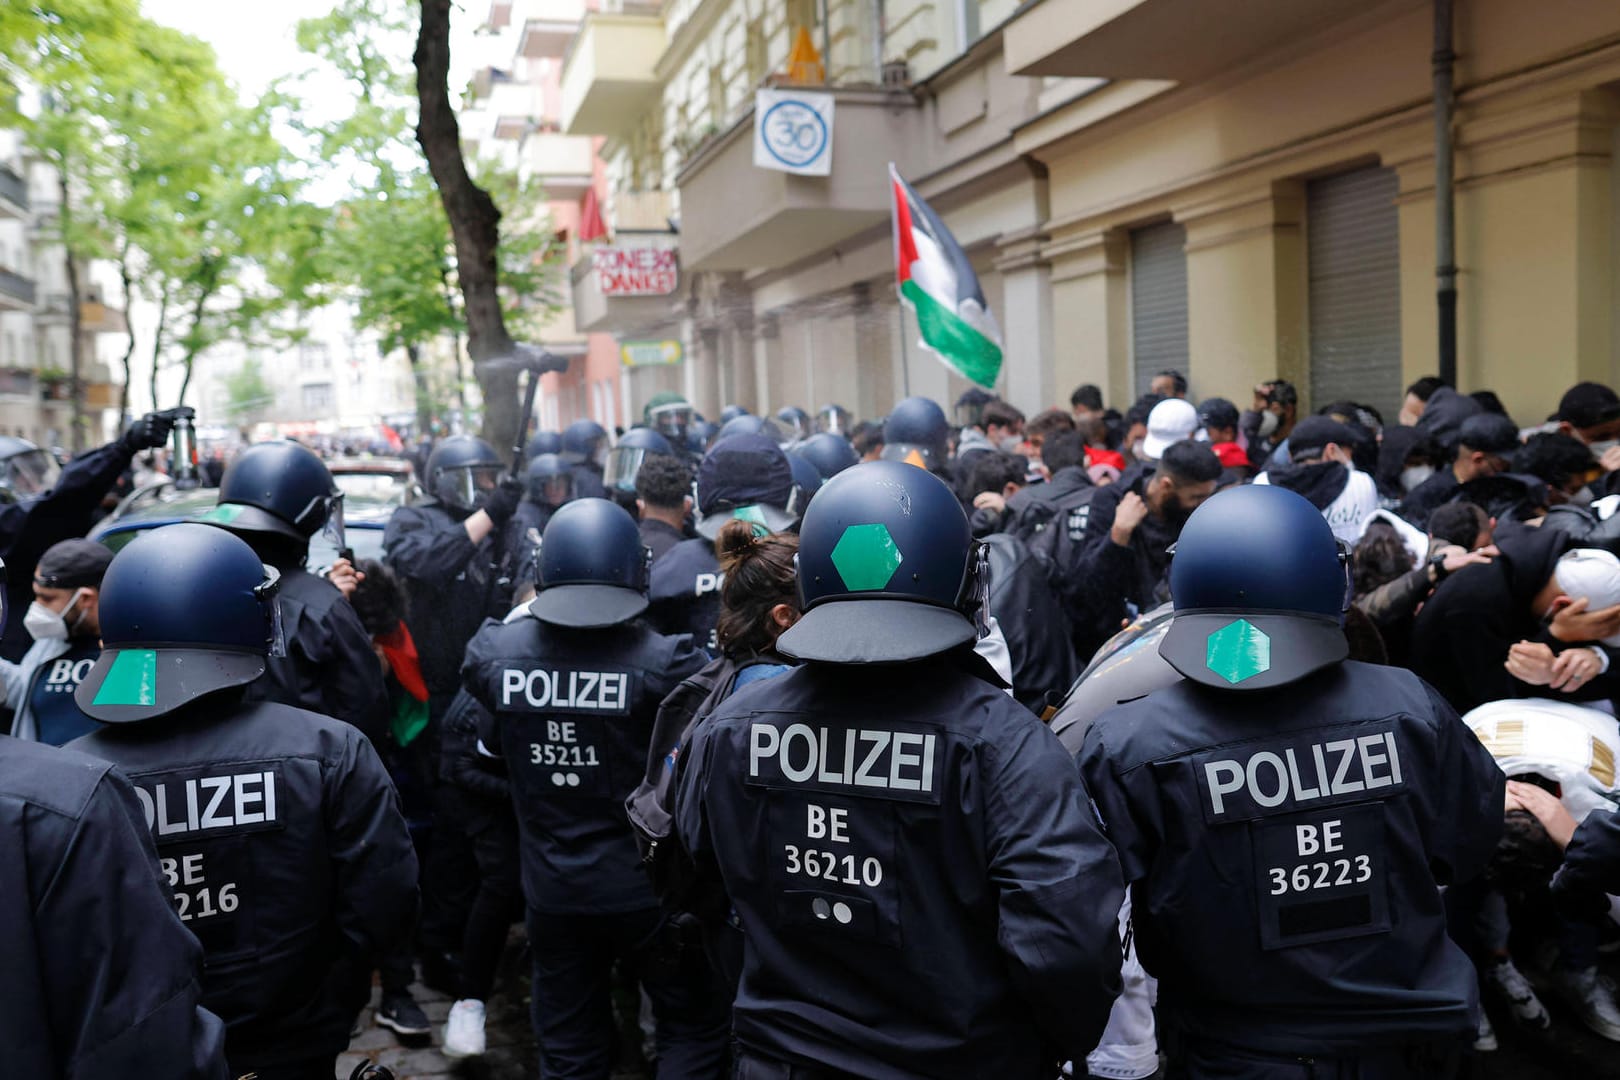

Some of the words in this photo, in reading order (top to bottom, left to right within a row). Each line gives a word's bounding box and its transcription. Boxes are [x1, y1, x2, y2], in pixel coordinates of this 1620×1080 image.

[502, 669, 628, 710] POLIZEI
[547, 720, 577, 744] BE
[530, 743, 599, 767] 35211
[749, 723, 936, 792] POLIZEI
[1204, 731, 1402, 815] POLIZEI
[807, 804, 850, 843] BE
[1296, 820, 1344, 857] BE
[785, 845, 883, 887] 36210
[1269, 855, 1372, 896] 36223
